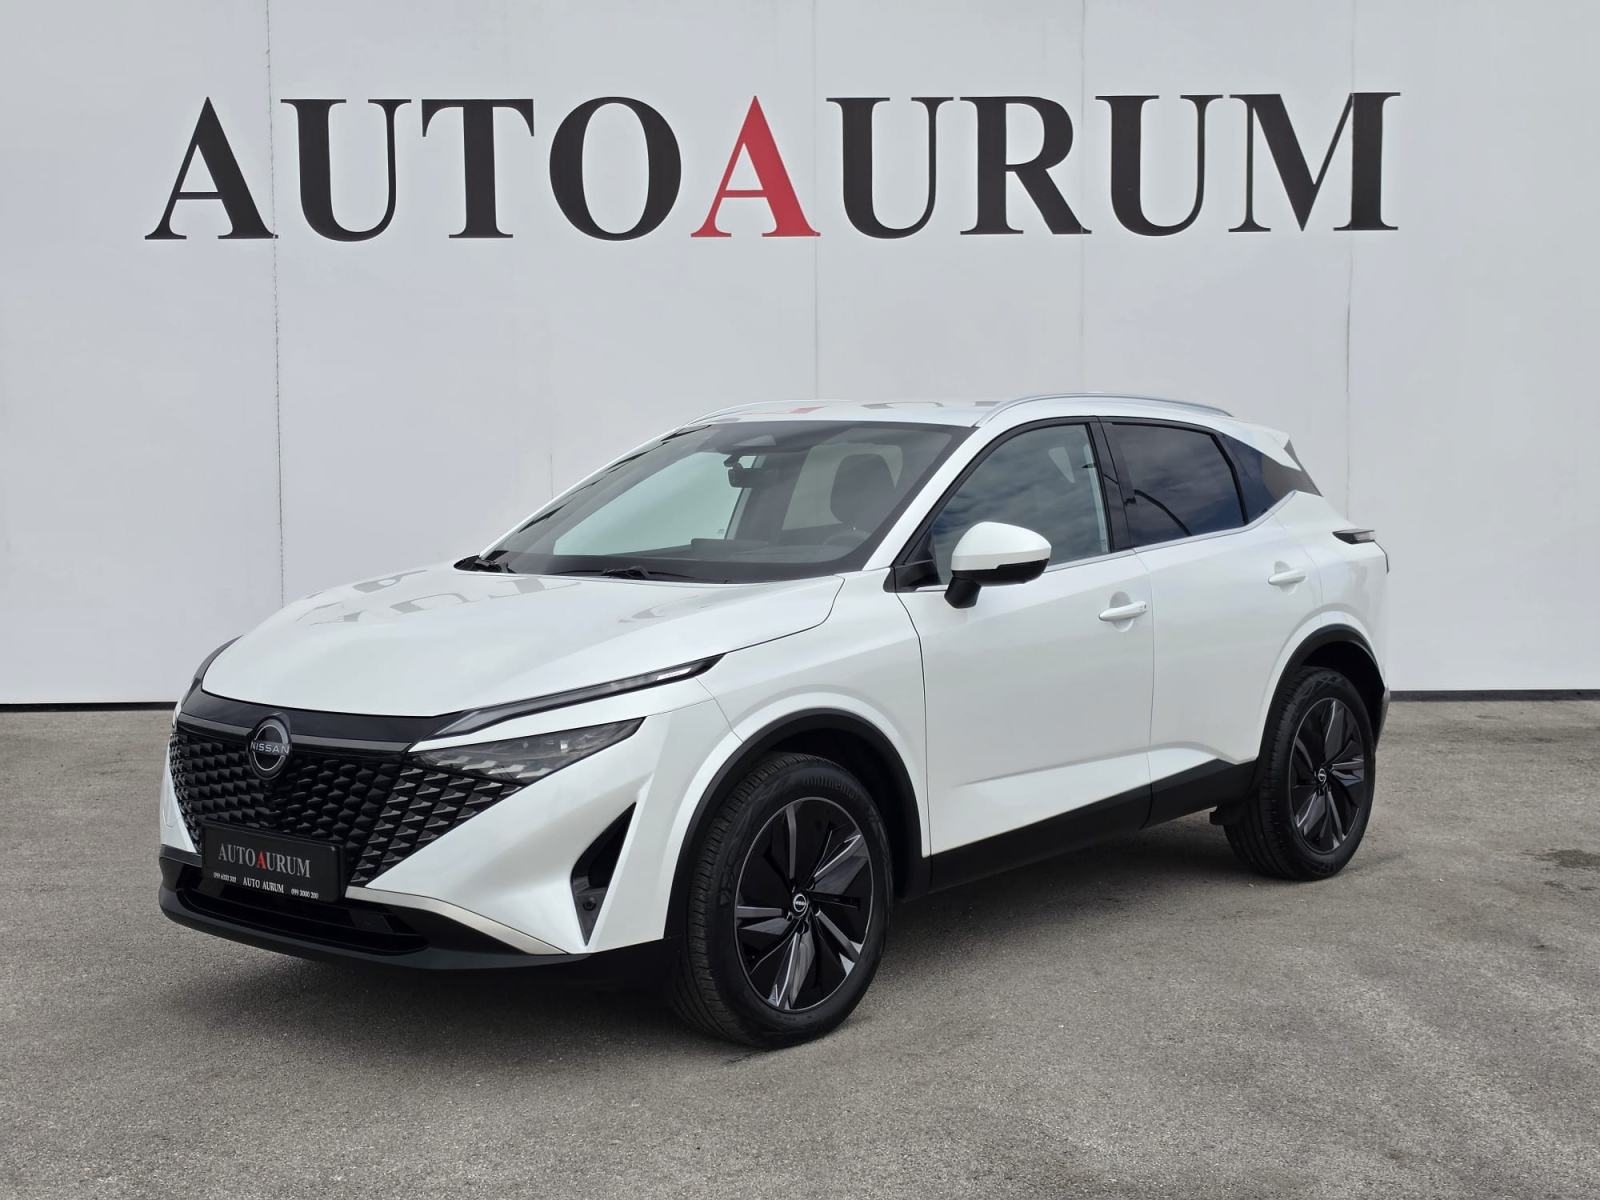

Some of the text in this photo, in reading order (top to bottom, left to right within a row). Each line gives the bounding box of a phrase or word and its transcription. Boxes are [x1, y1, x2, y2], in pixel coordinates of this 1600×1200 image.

[144, 93, 1401, 241] AUTOAURUM
[250, 741, 290, 754] NISSAN
[218, 843, 311, 878] AUTOAURUM
[242, 877, 284, 893] AUTO AURUM
